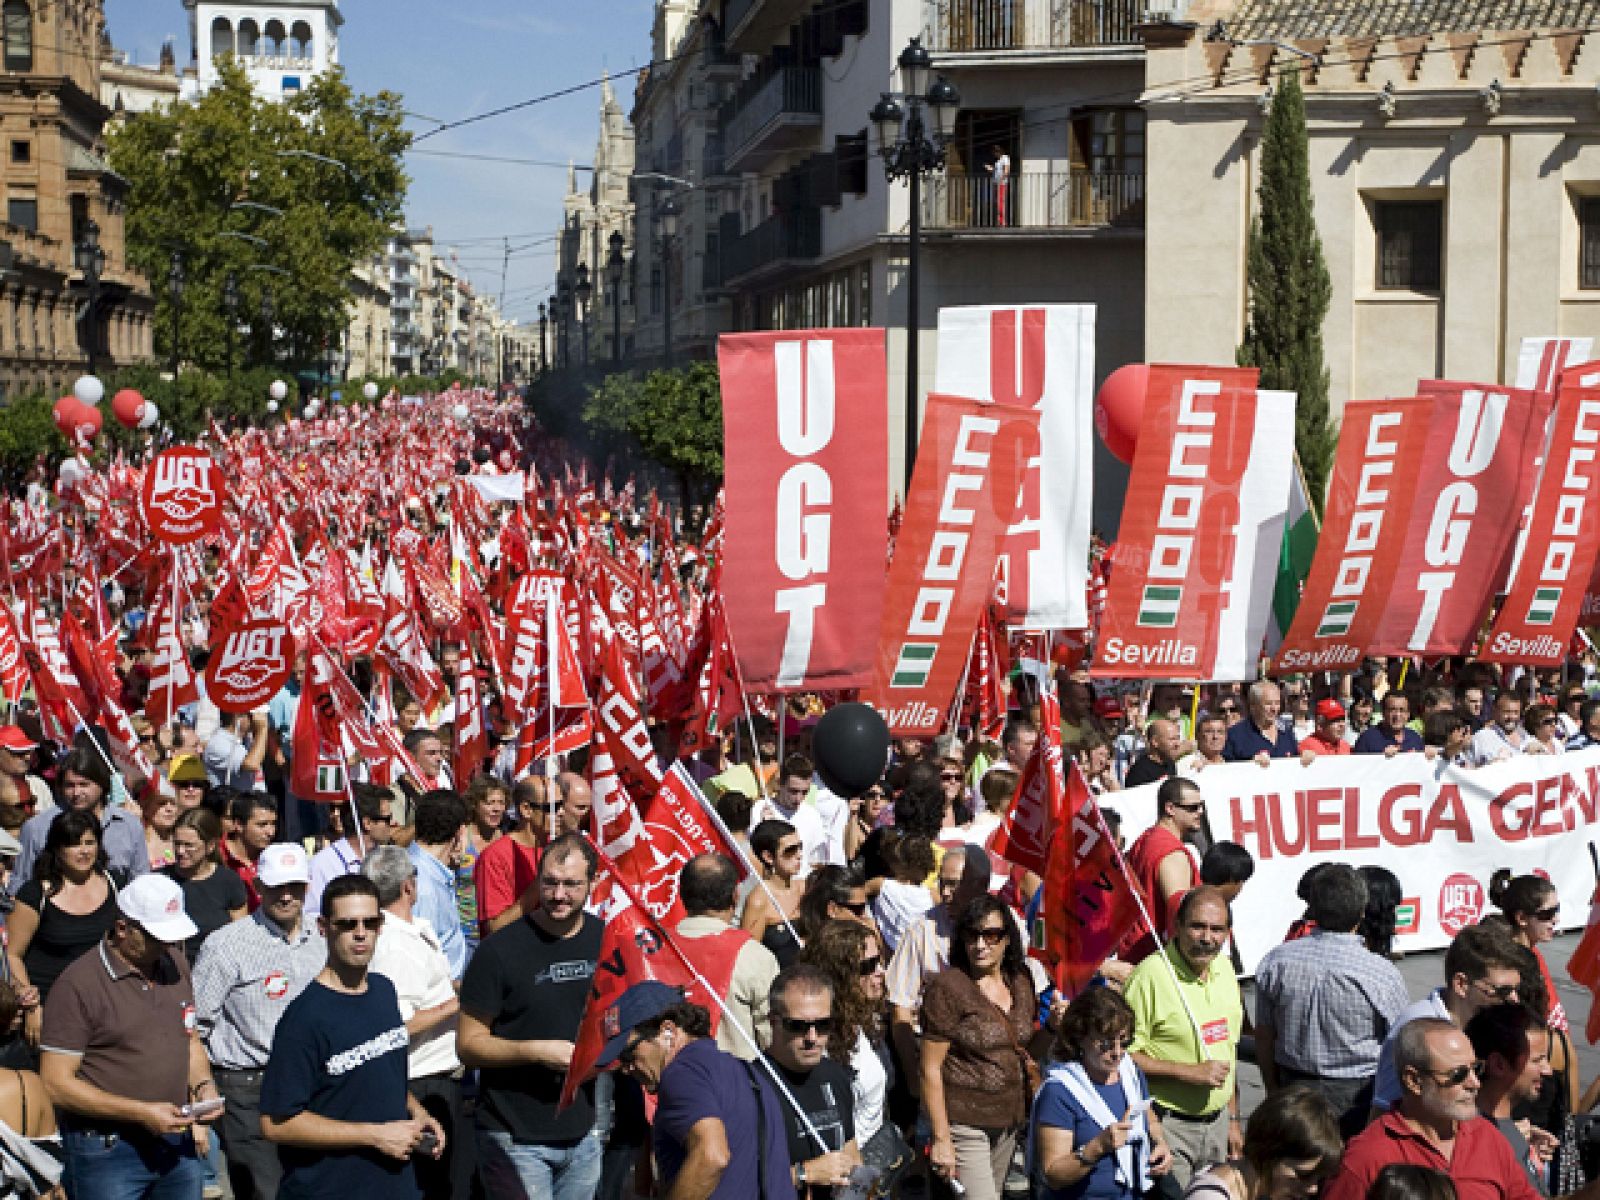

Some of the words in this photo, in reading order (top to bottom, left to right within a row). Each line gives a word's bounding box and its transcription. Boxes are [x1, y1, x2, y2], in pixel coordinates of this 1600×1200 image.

[155, 456, 211, 492] UGT
[774, 339, 836, 688] UGT
[1147, 379, 1221, 578] CCOO
[1332, 412, 1403, 596] CCOO
[1408, 391, 1509, 650] UGT
[1540, 402, 1600, 580] CCOO
[907, 415, 1001, 636] CCOO
[222, 626, 286, 668] UGT
[1104, 637, 1197, 665] Sevilla
[1280, 644, 1359, 668] Sevilla
[1490, 632, 1562, 657] Sevilla
[1230, 784, 1475, 861] HUELGA
[1488, 765, 1600, 842] GEN
[1443, 884, 1479, 914] UGT
